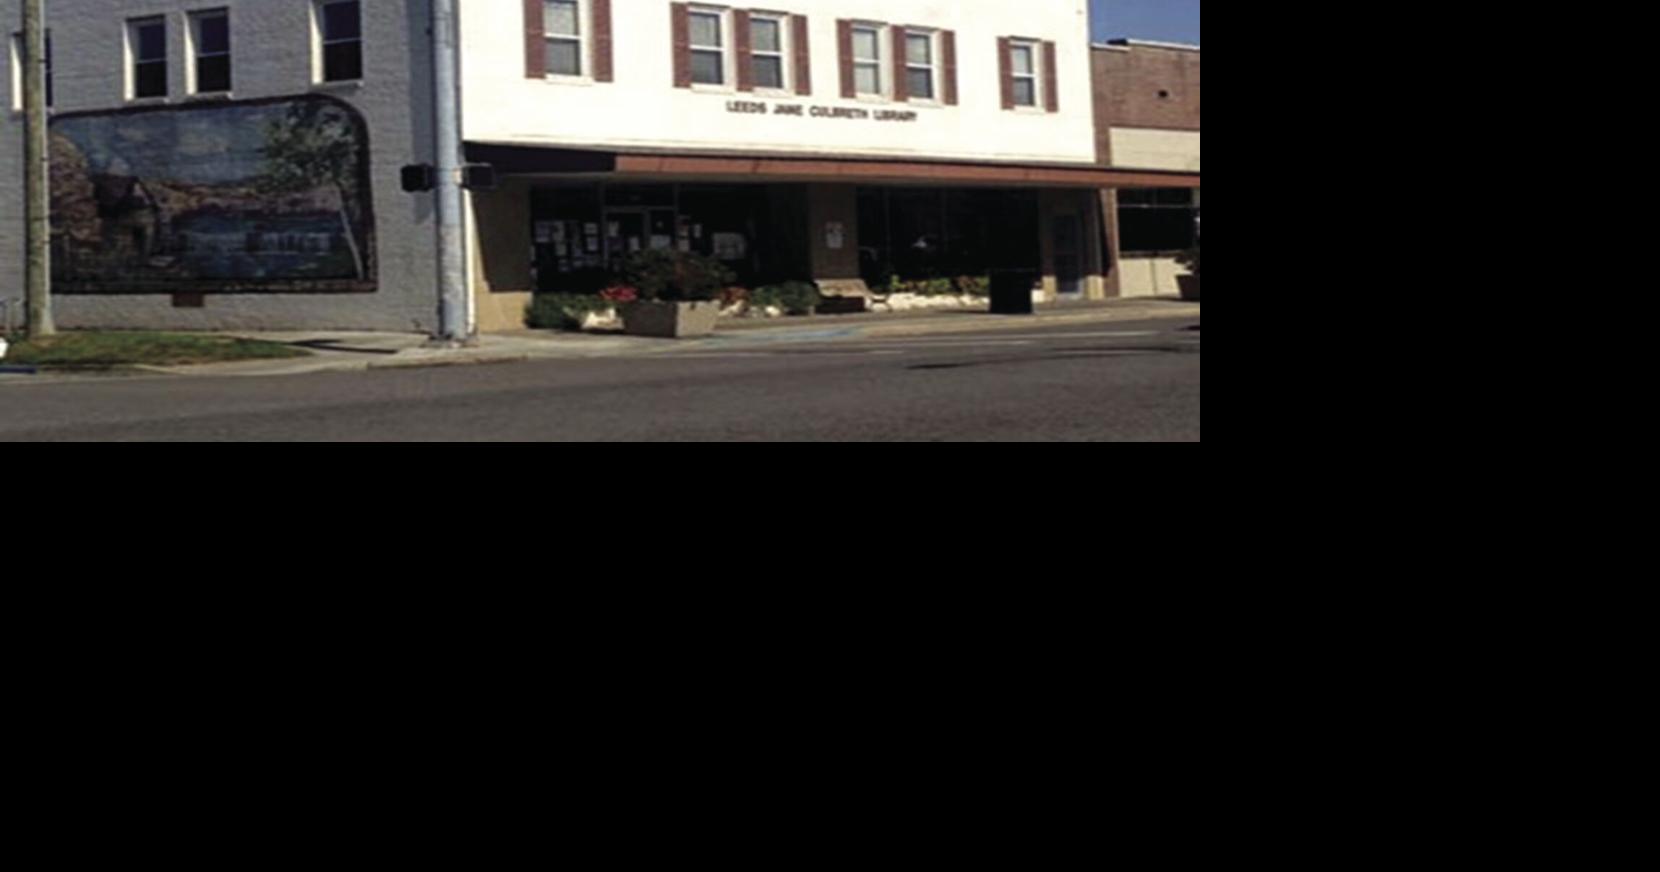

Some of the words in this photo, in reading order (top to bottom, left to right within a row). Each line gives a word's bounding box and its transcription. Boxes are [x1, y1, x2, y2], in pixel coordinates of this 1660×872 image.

[726, 101, 767, 114] LEEDS
[773, 103, 803, 116] JANE
[809, 105, 868, 119] CULBRETH
[873, 109, 917, 122] LIBRARY
